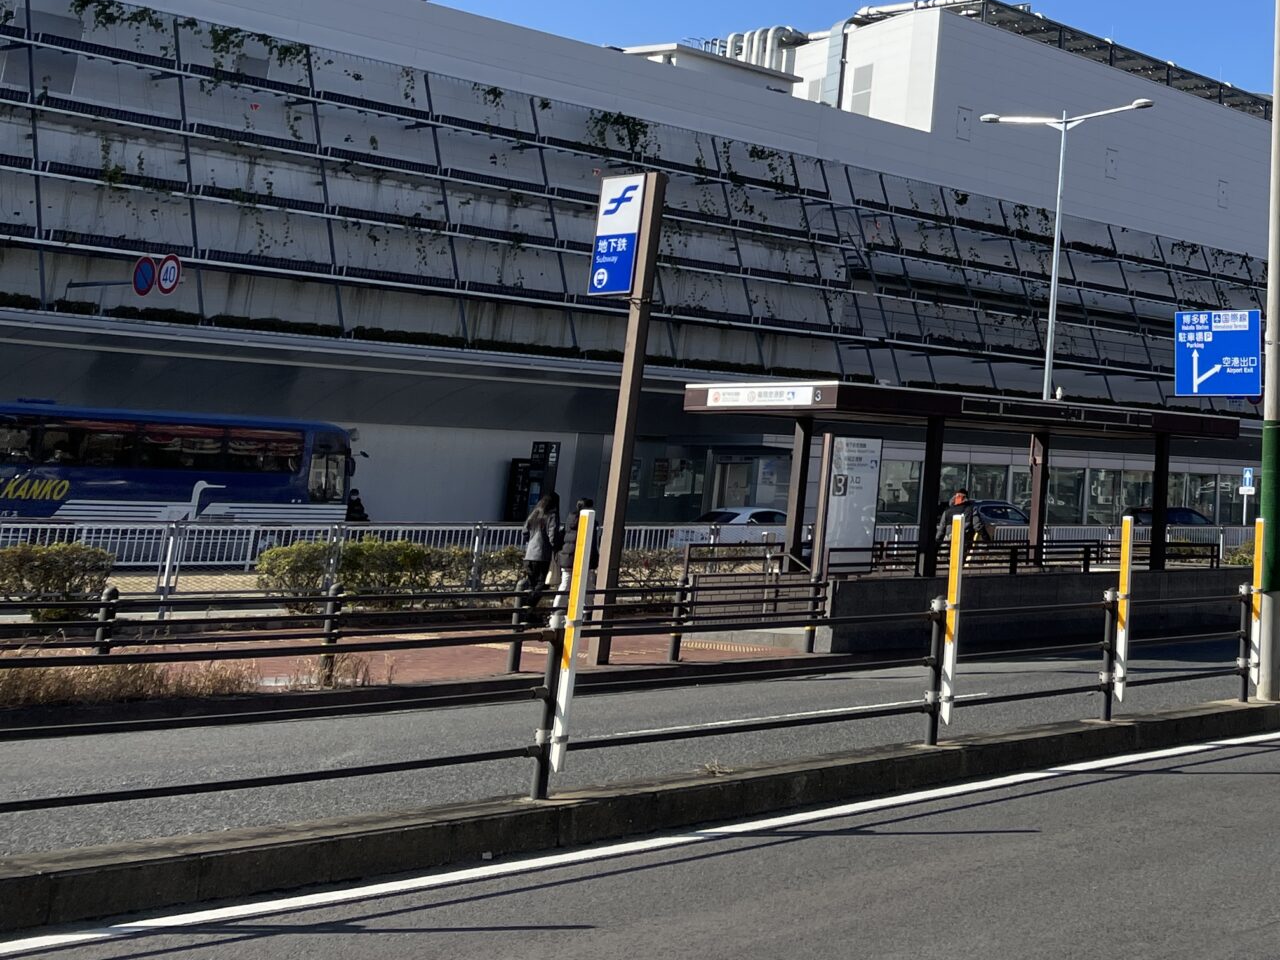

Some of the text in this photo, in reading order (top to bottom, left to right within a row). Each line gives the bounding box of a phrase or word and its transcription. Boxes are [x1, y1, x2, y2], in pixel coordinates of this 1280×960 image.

[597, 237, 628, 253] 地下鉄
[596, 255, 618, 264] Subway
[163, 266, 176, 283] 40
[1182, 314, 1209, 324] 博多駅
[1178, 332, 1204, 342] 駐車場
[1186, 342, 1205, 350] Parking
[1222, 356, 1257, 367] 空港出口
[815, 390, 822, 401] 3
[835, 476, 845, 495] 3
[849, 476, 861, 485] 入口
[0, 477, 70, 500] KANKO
